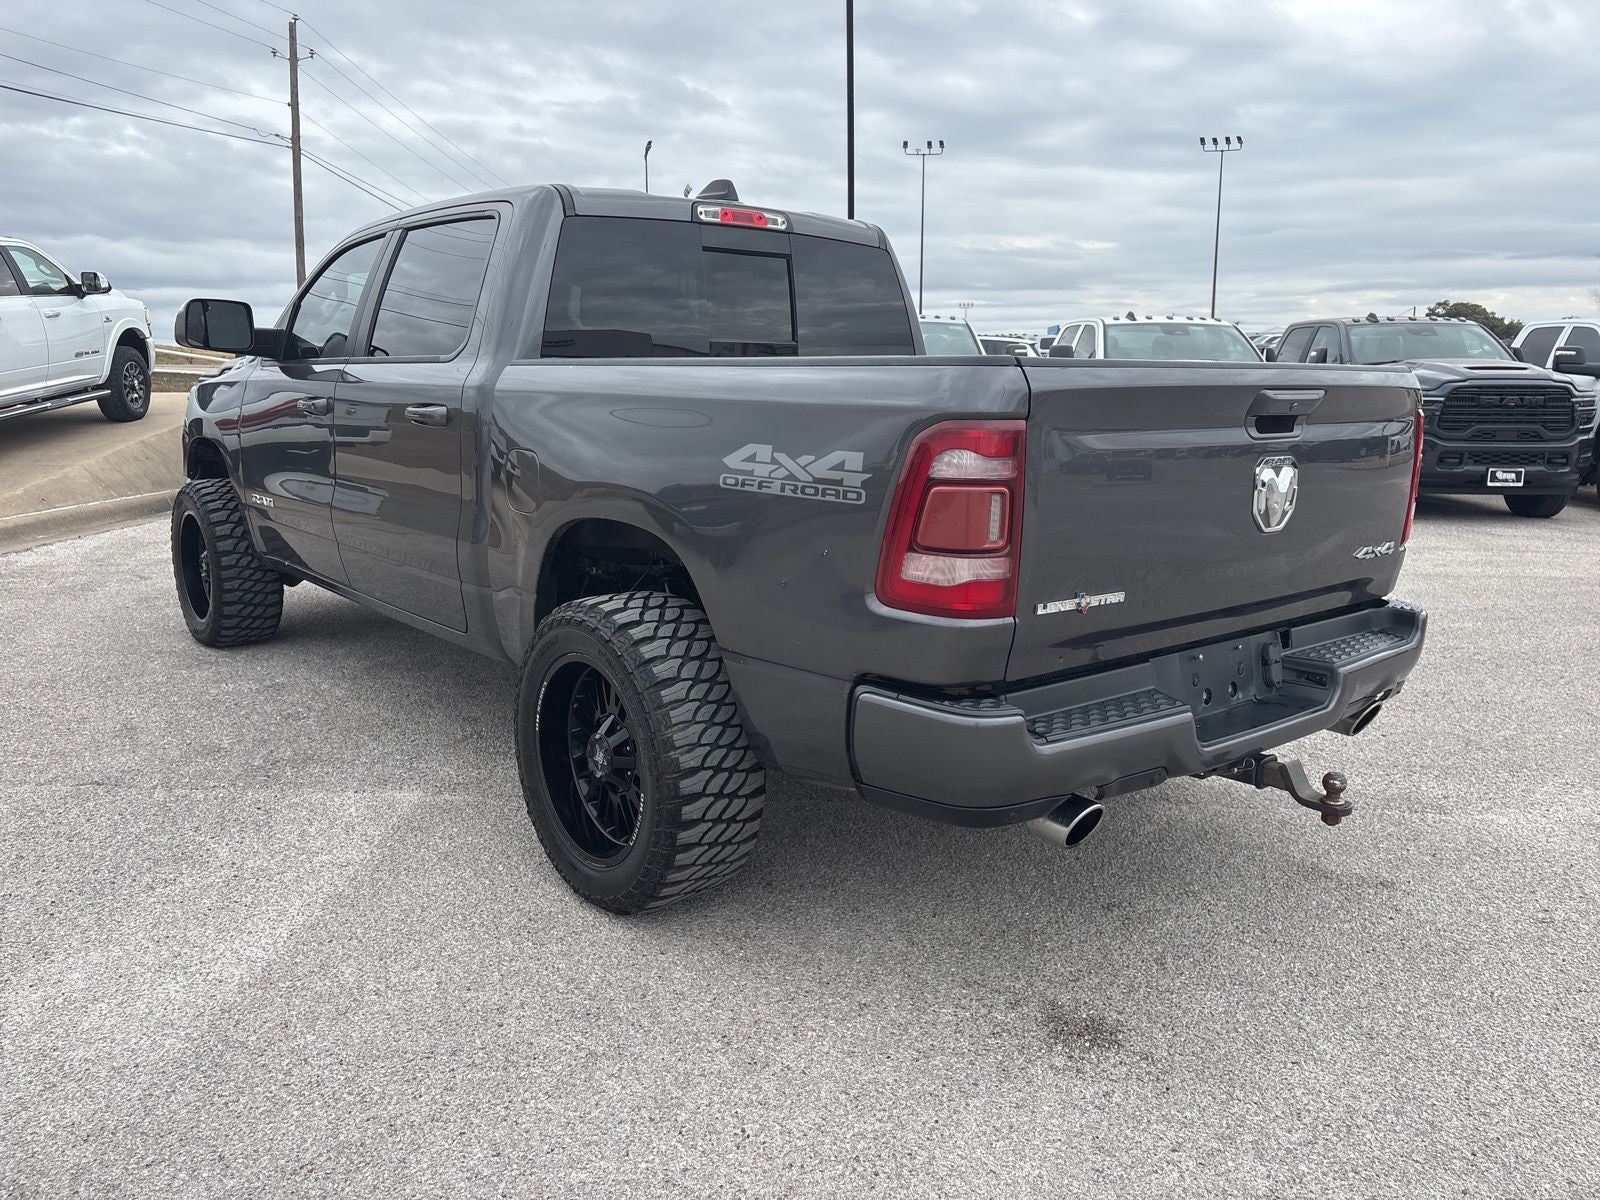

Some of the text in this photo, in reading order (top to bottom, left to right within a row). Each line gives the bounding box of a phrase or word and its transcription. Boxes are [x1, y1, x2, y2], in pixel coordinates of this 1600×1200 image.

[721, 475, 863, 503] OFF ROAD
[251, 493, 275, 508] RAM
[1090, 591, 1126, 607] STAR
